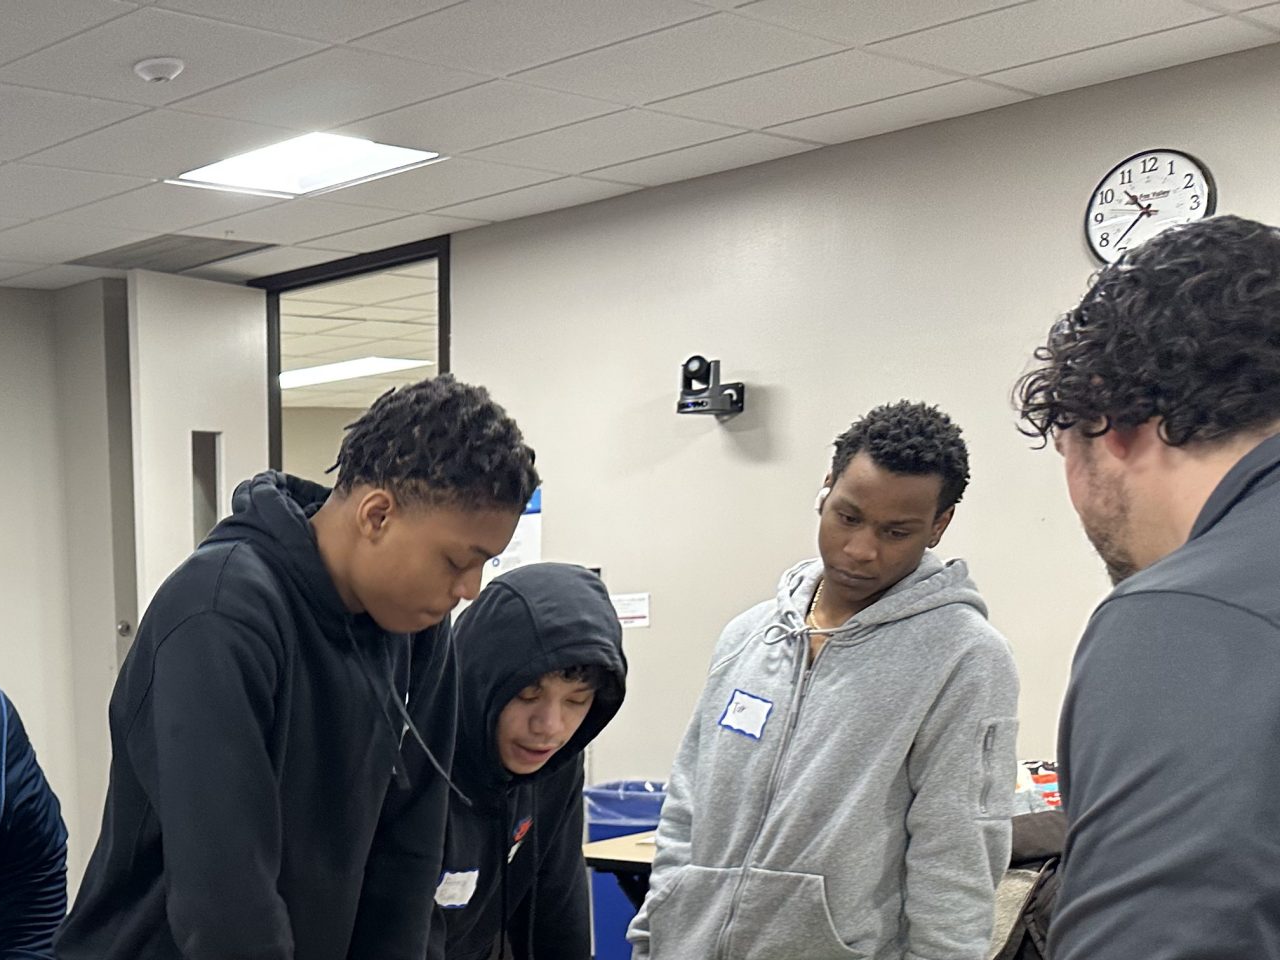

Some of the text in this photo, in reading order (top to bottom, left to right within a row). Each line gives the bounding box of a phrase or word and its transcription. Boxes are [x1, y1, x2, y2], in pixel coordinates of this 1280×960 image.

[1141, 156, 1158, 174] 12
[1167, 160, 1176, 176] 1
[1119, 169, 1133, 185] 11
[1183, 173, 1195, 190] 2
[1099, 189, 1114, 205] 10
[1189, 194, 1201, 211] 3
[1094, 213, 1104, 225] 9
[1099, 232, 1110, 248] 8
